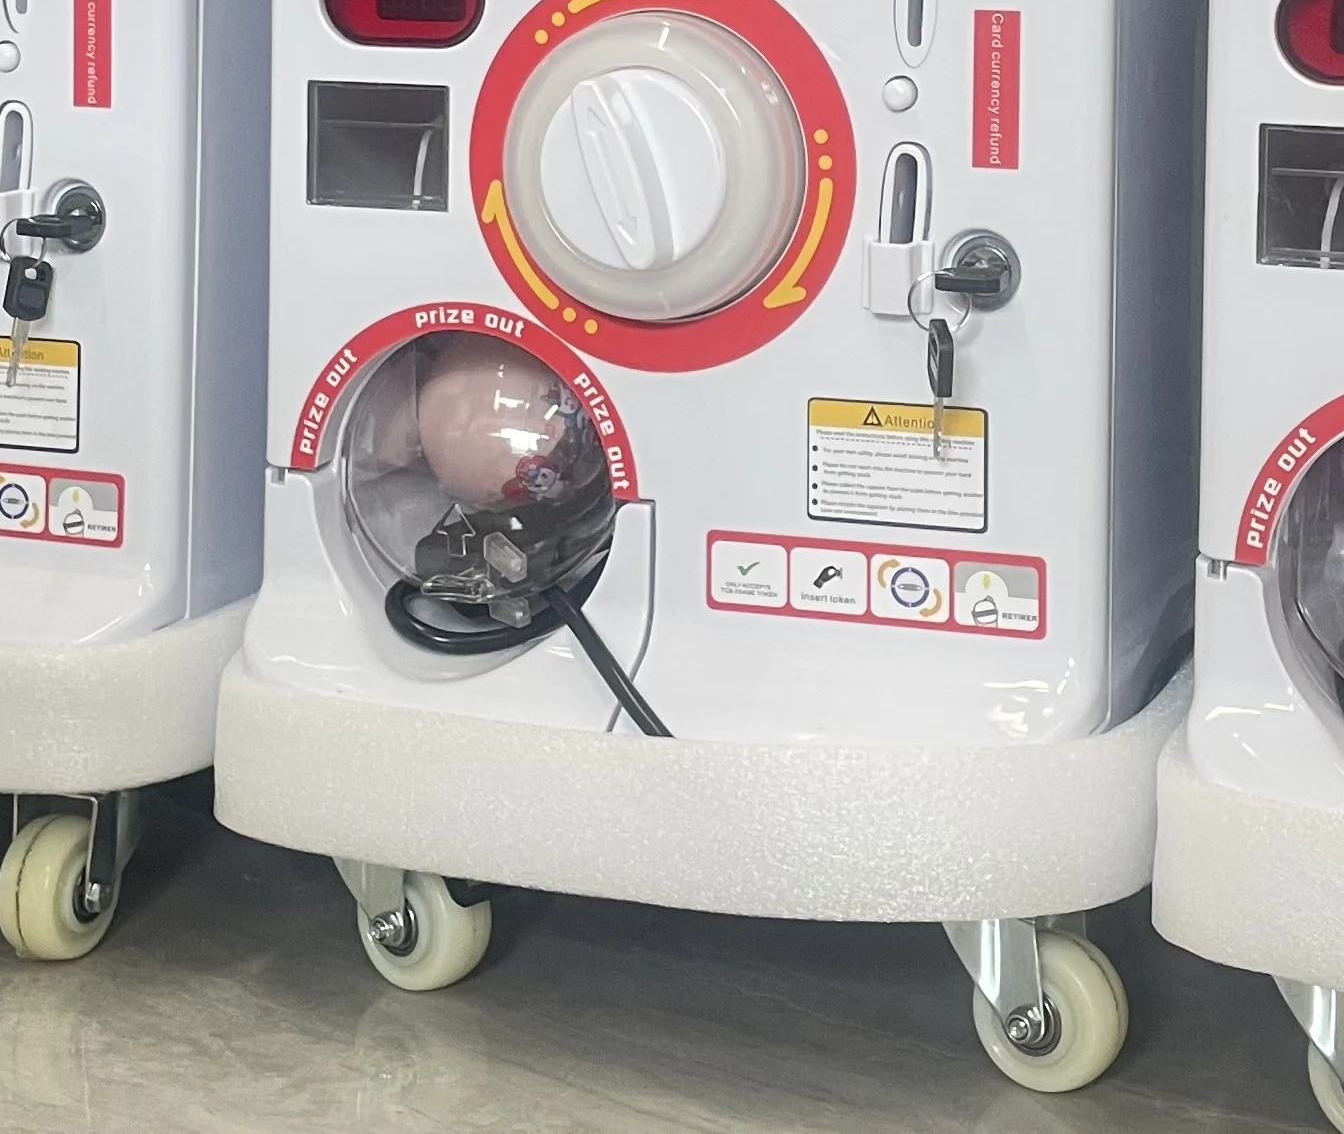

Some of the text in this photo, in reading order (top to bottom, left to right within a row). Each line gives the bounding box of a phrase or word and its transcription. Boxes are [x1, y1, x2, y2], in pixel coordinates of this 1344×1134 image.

[86, 2, 96, 60] currency
[87, 61, 98, 105] refund
[988, 13, 1005, 165] Card currency refund
[415, 306, 525, 338] prize out
[299, 348, 359, 456] prize out
[573, 372, 630, 491] prize out
[884, 415, 936, 430] Attentio
[1246, 427, 1317, 549] prize out
